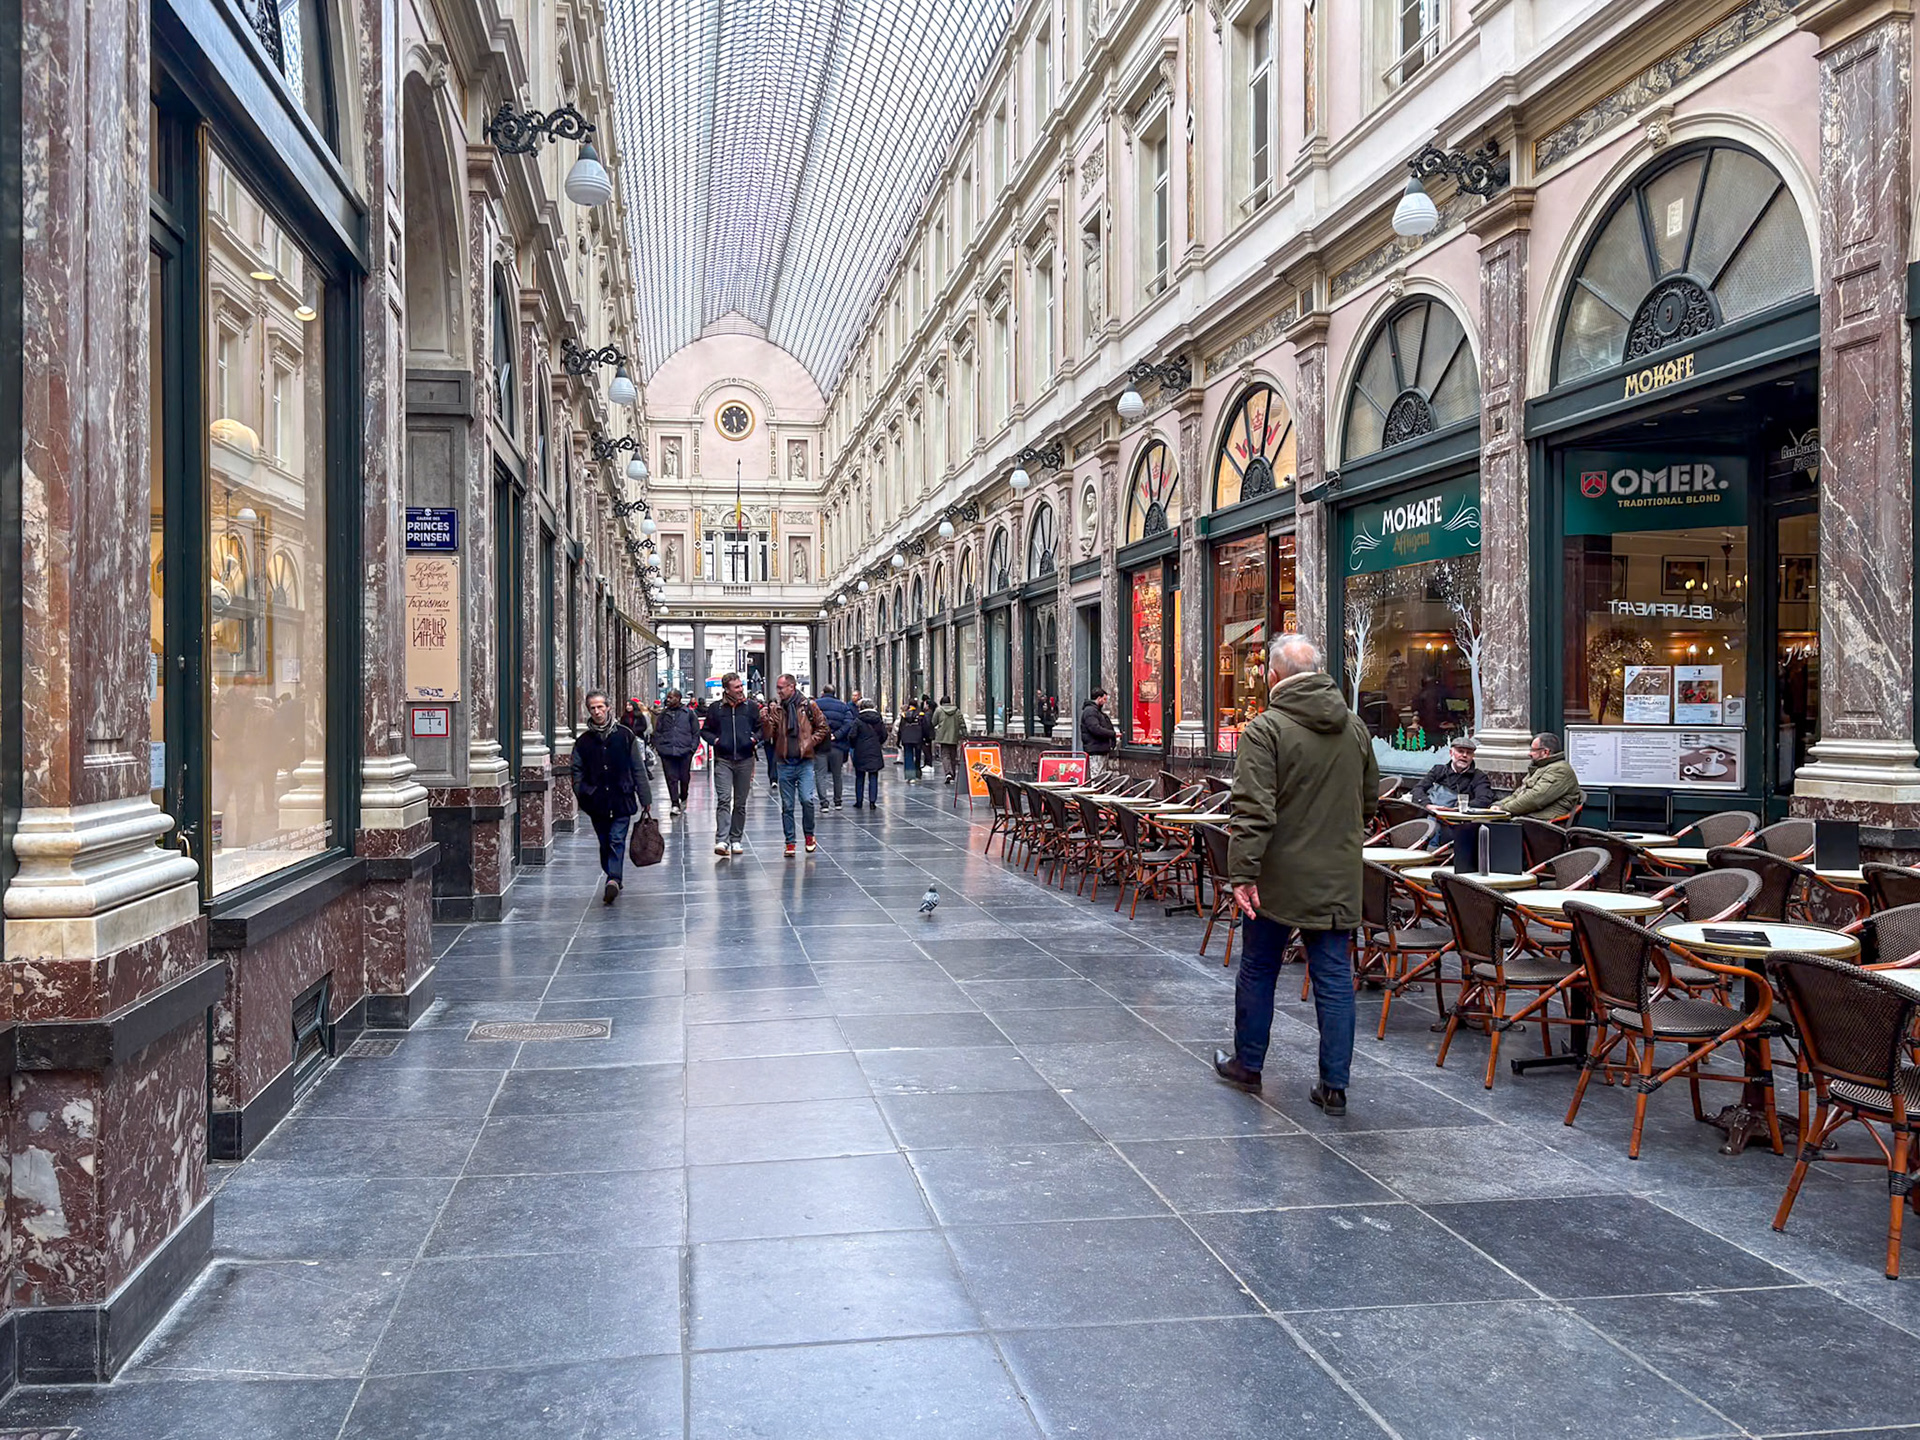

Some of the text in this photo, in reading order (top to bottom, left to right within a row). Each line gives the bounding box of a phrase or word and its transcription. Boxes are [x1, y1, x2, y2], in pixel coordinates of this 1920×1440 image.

[1624, 353, 1695, 399] MOKAFE
[1611, 464, 1729, 496] OMER.
[1617, 494, 1721, 508] TRADITIONAL BLOND
[407, 522, 449, 531] PRINCES
[1381, 496, 1443, 536] MOKAFE
[407, 532, 450, 542] PRINSEN
